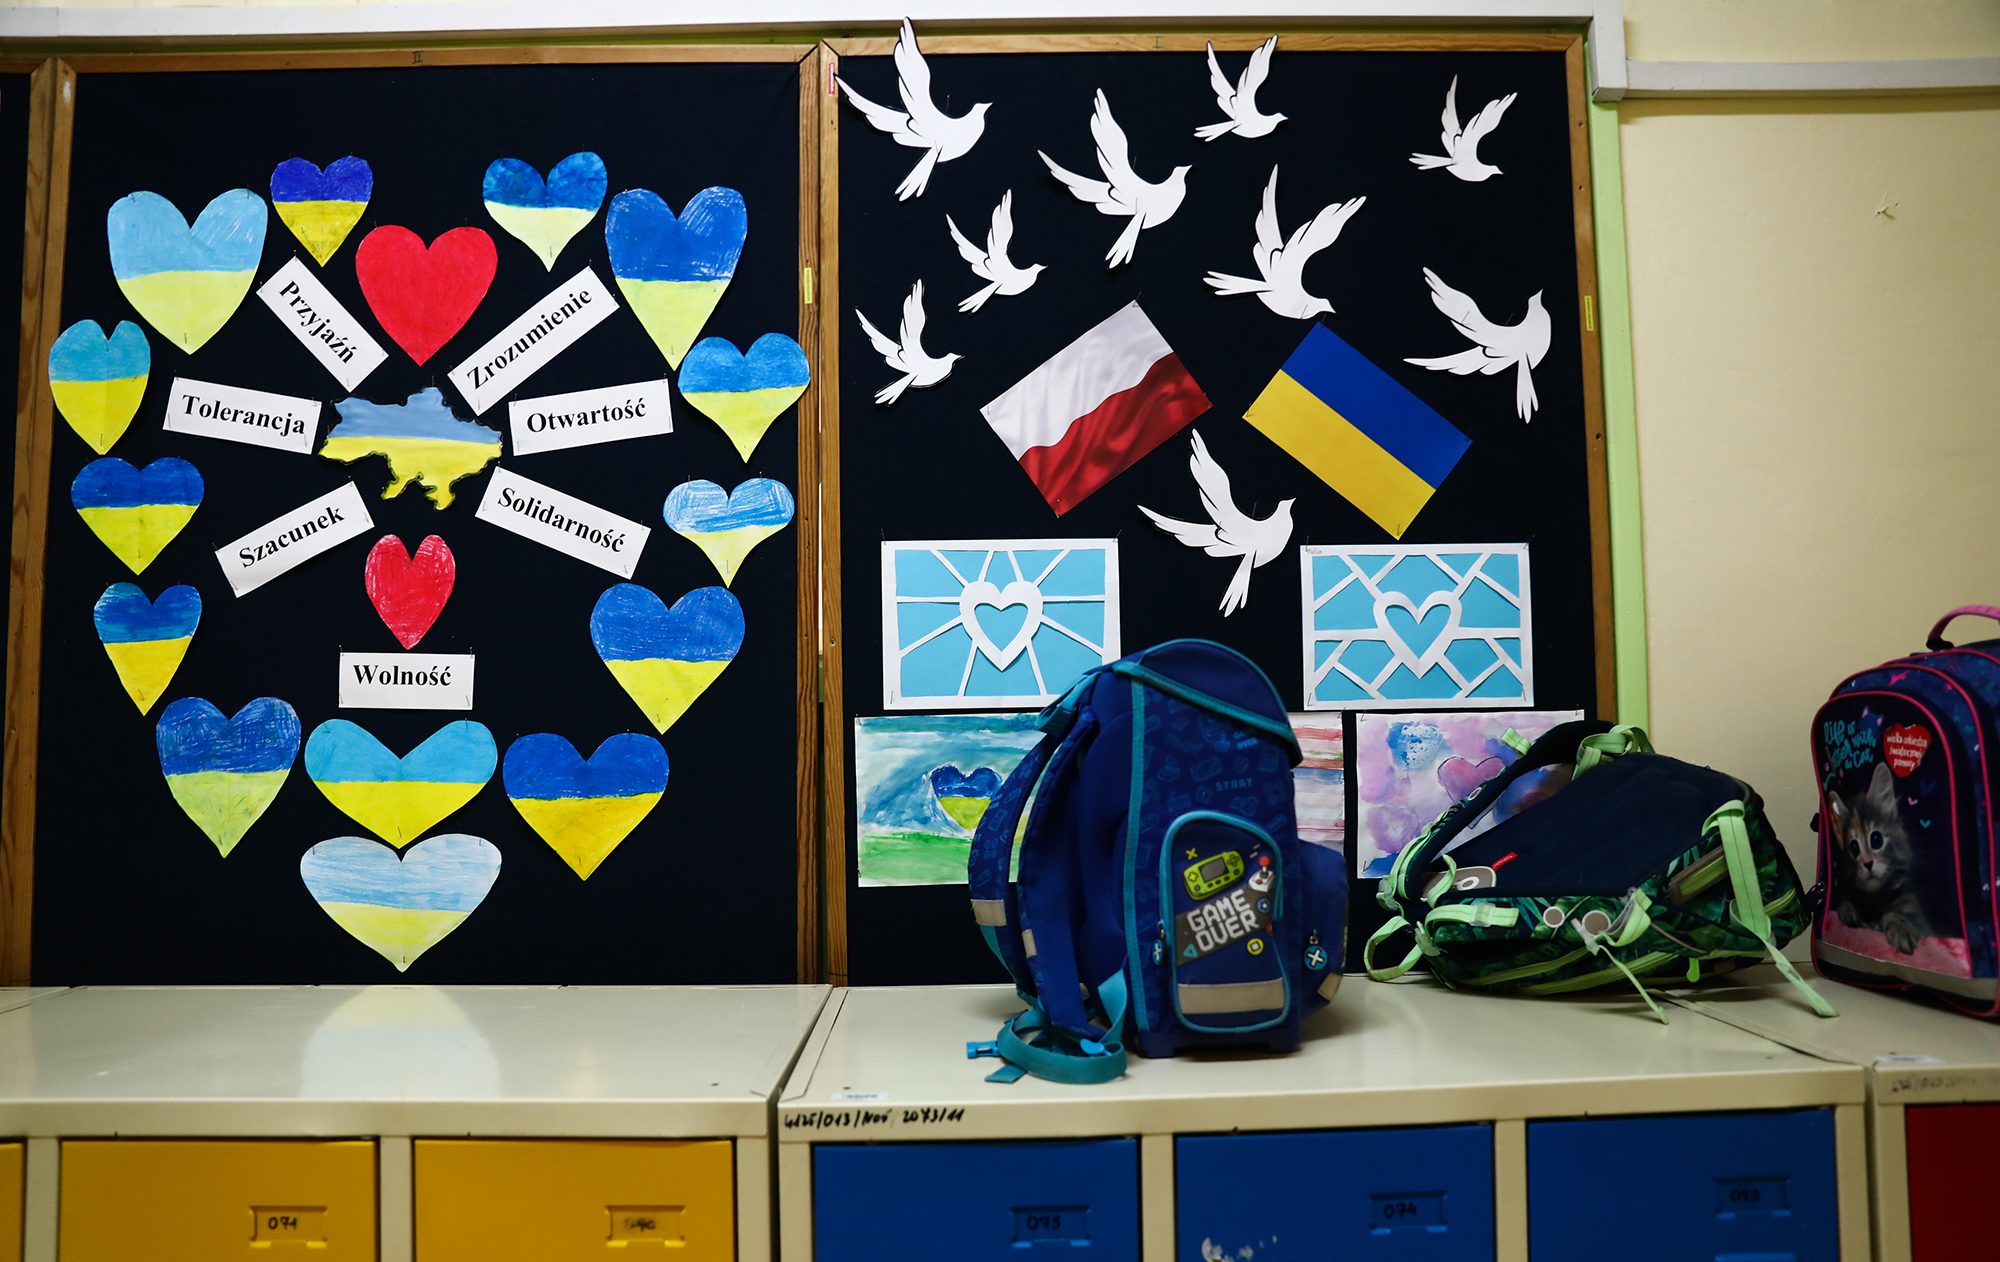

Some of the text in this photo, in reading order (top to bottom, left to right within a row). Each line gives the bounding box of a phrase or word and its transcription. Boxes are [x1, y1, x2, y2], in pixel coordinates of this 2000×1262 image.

[279, 280, 354, 364] Przyjaźń
[466, 291, 592, 390] Zrozumienie
[182, 394, 305, 437] Tolerancja
[527, 399, 646, 433] Otwartość
[239, 506, 345, 568] Szacunek
[497, 487, 626, 553] Solidarność
[353, 664, 451, 686] Wolność
[1823, 720, 1845, 746] life
[1851, 728, 1877, 748] with
[1853, 748, 1874, 768] cat
[1215, 778, 1252, 791] START
[1186, 889, 1251, 934] GAME
[1194, 910, 1260, 952] OVER
